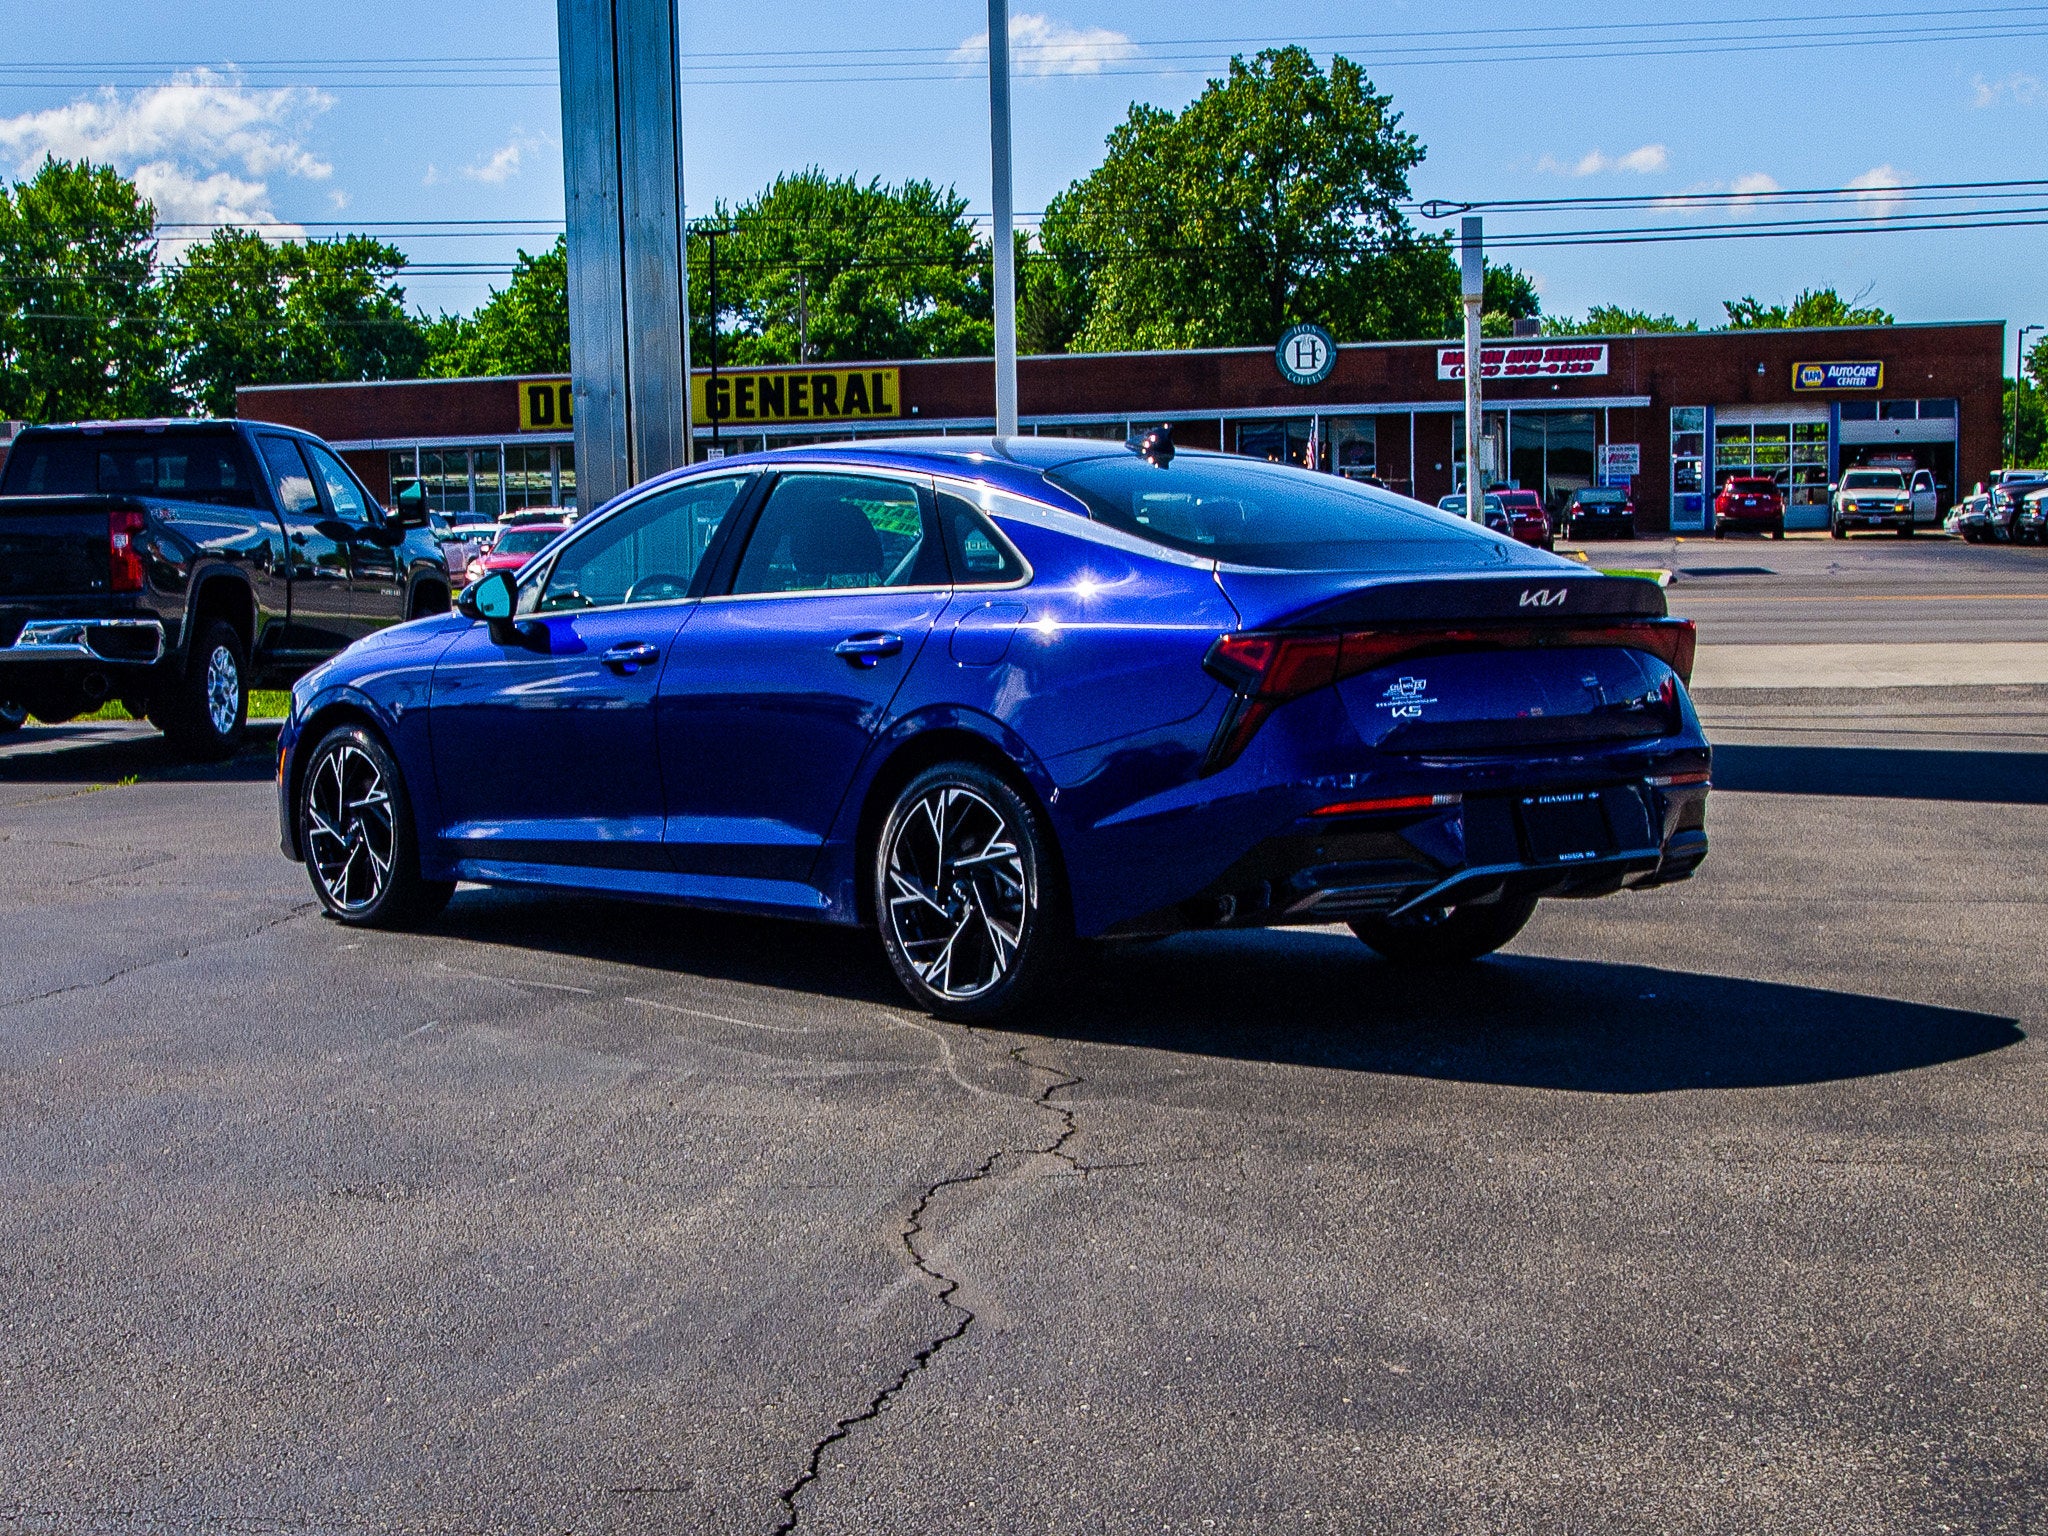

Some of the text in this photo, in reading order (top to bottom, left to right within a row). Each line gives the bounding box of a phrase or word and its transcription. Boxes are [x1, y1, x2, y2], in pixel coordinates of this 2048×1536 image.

[1505, 349, 1543, 364] AUTO
[1543, 346, 1603, 362] SERVICE
[1837, 377, 1867, 386] CENTER
[705, 372, 893, 420] GENERAL
[1519, 588, 1568, 606] KIA
[1392, 705, 1422, 718] K5
